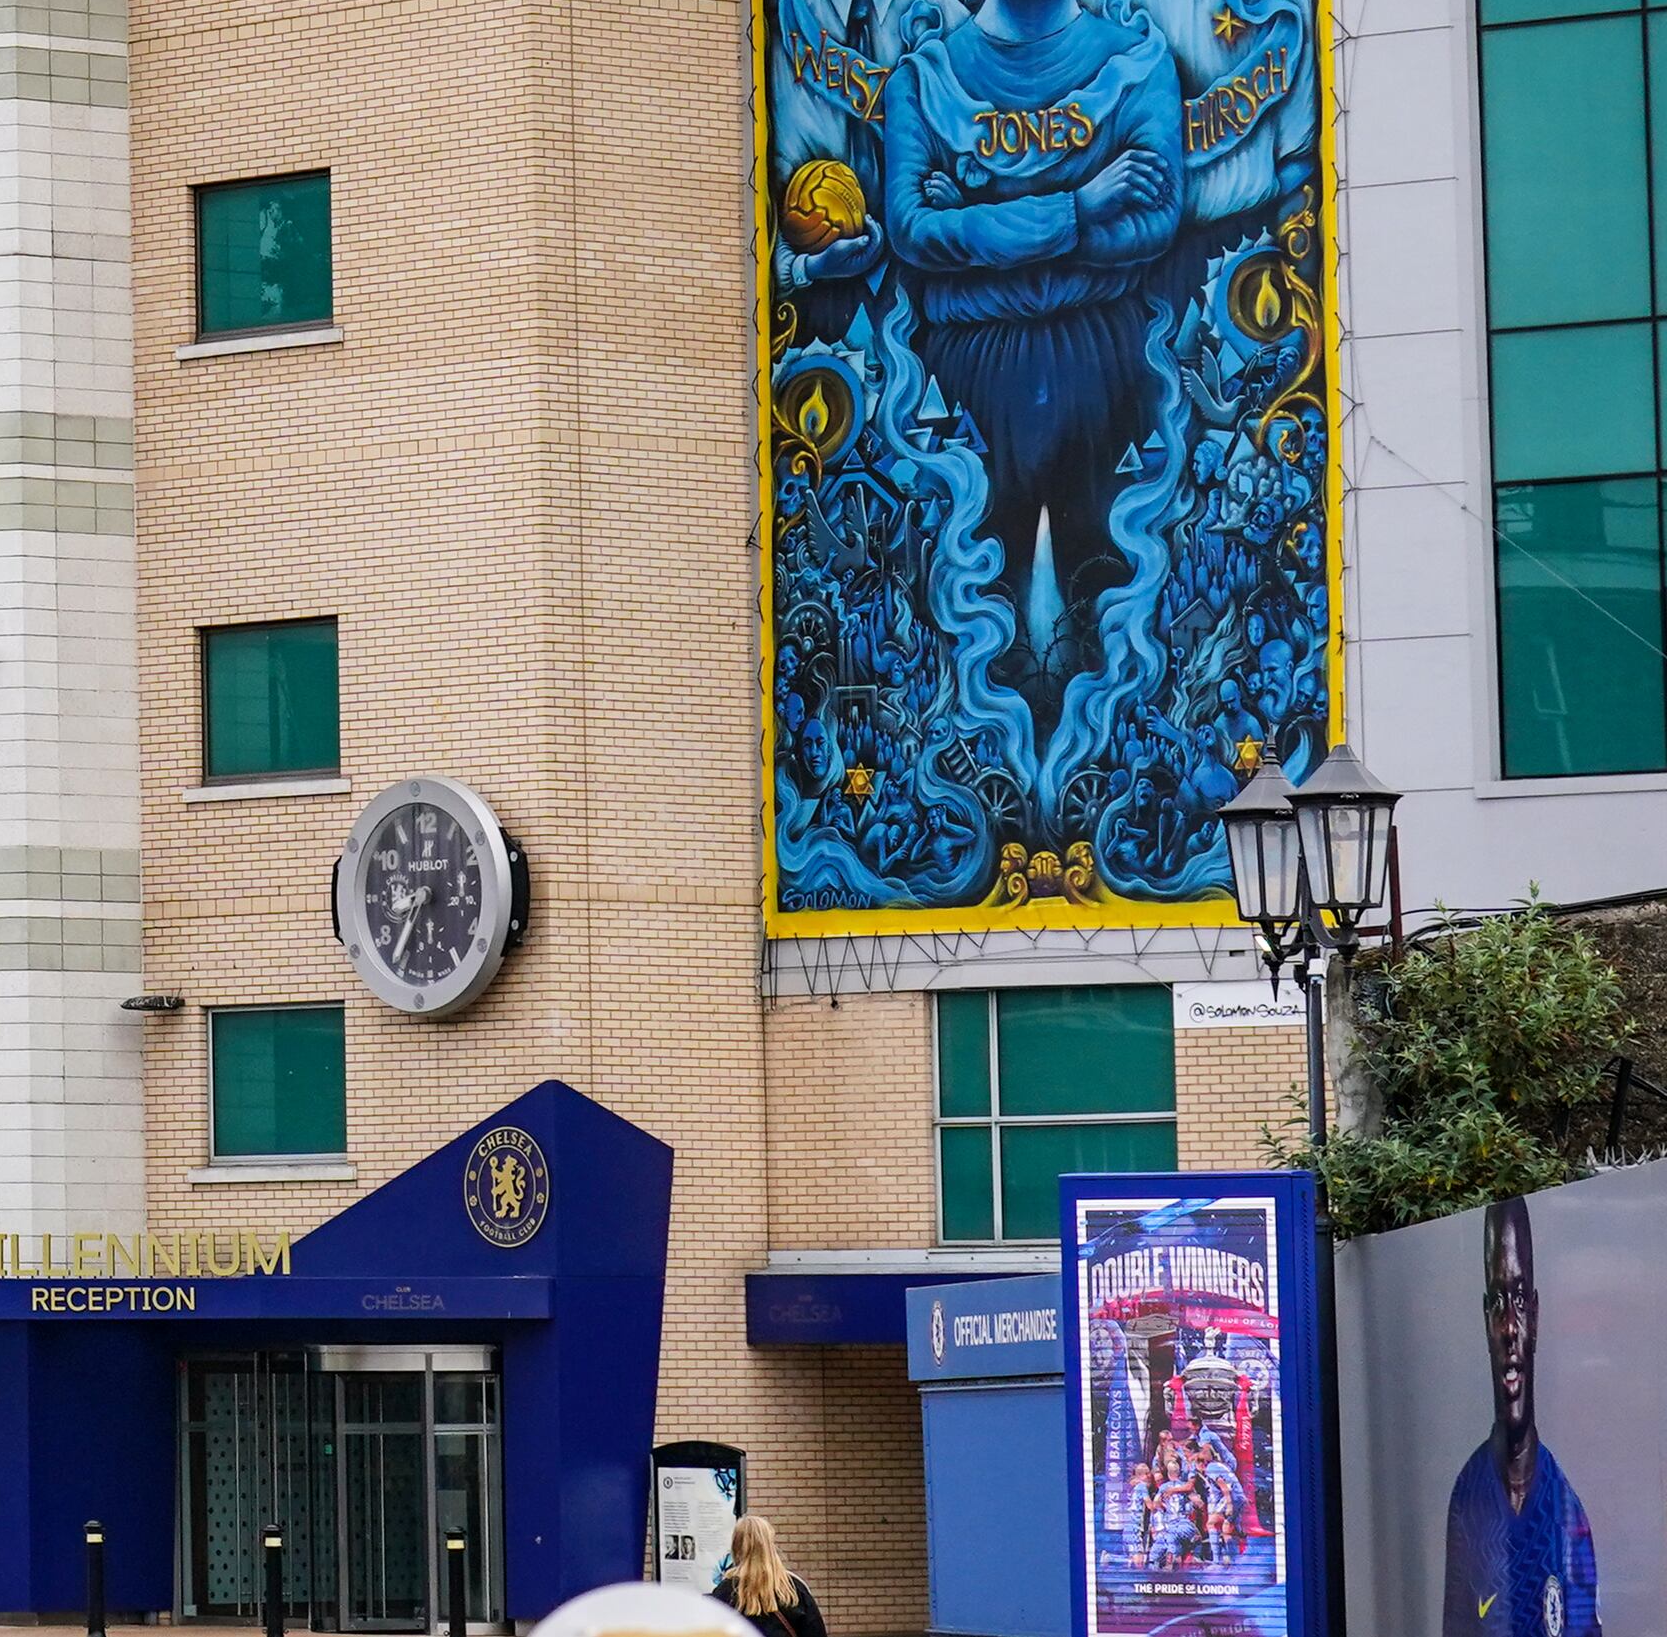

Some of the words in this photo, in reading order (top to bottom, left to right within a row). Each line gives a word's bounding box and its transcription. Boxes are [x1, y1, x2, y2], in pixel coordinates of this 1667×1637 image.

[791, 29, 891, 123] WEISZ
[1183, 47, 1288, 154] HIRSCH
[974, 102, 1095, 157] JONES
[415, 811, 438, 834] 12
[379, 849, 400, 872] 10
[408, 858, 449, 872] HUBLOT
[466, 845, 478, 866] 2
[782, 888, 872, 909] SOLOMON
[380, 924, 392, 945] 8
[478, 1131, 534, 1157] CHELSEA
[479, 1220, 516, 1241] FOOTBALL
[518, 1218, 536, 1236] CLUB
[1091, 1246, 1165, 1306] DOUBLE
[1169, 1246, 1265, 1307] WINNERS
[31, 1286, 195, 1312] RECEPTION
[362, 1295, 445, 1310] CHELSEA
[954, 1313, 992, 1347] OFFICIAL
[994, 1308, 1058, 1345] MERCHANDISE
[1108, 1389, 1123, 1460] BARCLAYS
[1134, 1583, 1153, 1594] THE
[1154, 1583, 1184, 1594] PRIDE
[1197, 1584, 1240, 1595] LONDON
